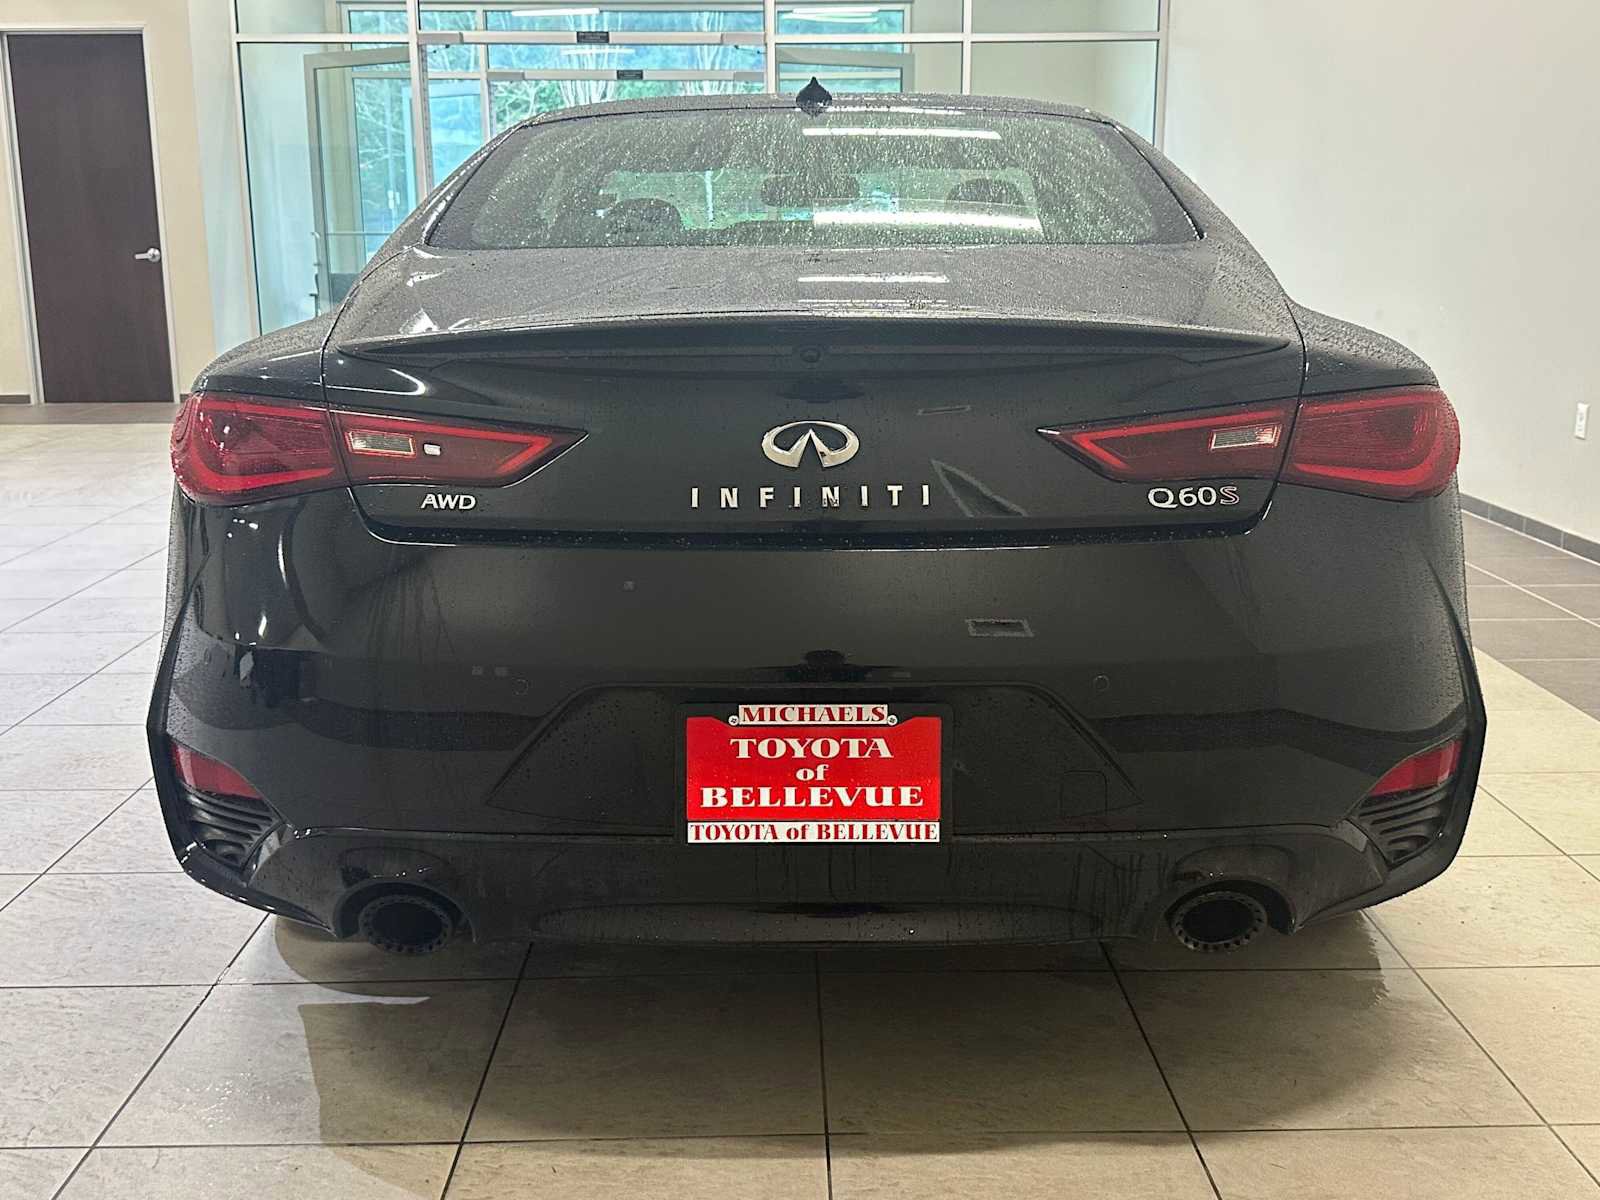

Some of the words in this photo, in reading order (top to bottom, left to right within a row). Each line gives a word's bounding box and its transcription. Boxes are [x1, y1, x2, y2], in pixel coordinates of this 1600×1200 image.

[420, 493, 476, 510] AWD
[691, 484, 930, 508] INFINITI
[742, 706, 885, 722] MICHAELS
[730, 738, 894, 758] TOYOTA
[796, 764, 829, 781] of
[700, 786, 924, 808] BELLEVUE
[690, 823, 778, 841] TOYOTA
[786, 823, 810, 841] of
[816, 823, 937, 841] BELLEVUE
